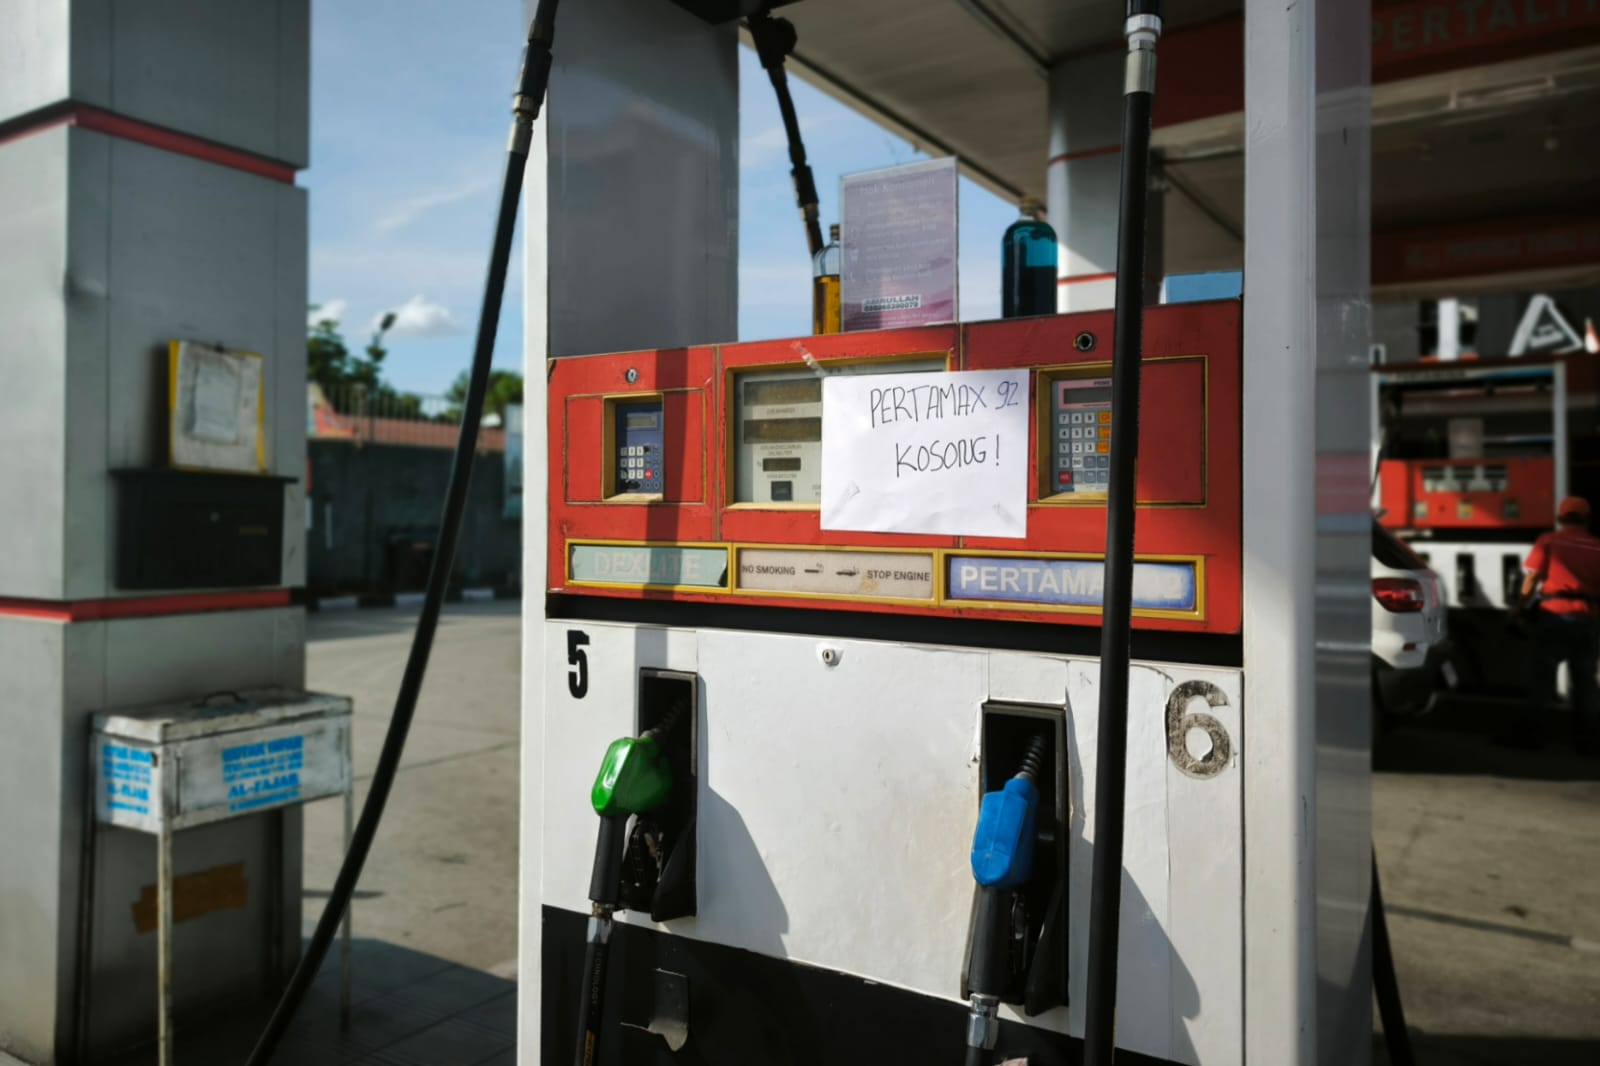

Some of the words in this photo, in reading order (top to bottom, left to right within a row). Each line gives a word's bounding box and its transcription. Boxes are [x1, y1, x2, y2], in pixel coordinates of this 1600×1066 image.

[870, 383, 987, 429] PERTAMAX
[995, 381, 1019, 410] 92
[594, 551, 701, 580] DEXLITE
[741, 565, 754, 574] NO
[756, 565, 796, 576] SMOKING
[866, 569, 892, 580] STOP
[893, 570, 930, 582] ENGINE
[960, 565, 1105, 597] PERTAMA
[567, 629, 590, 699] 5
[1165, 680, 1230, 780] 6
